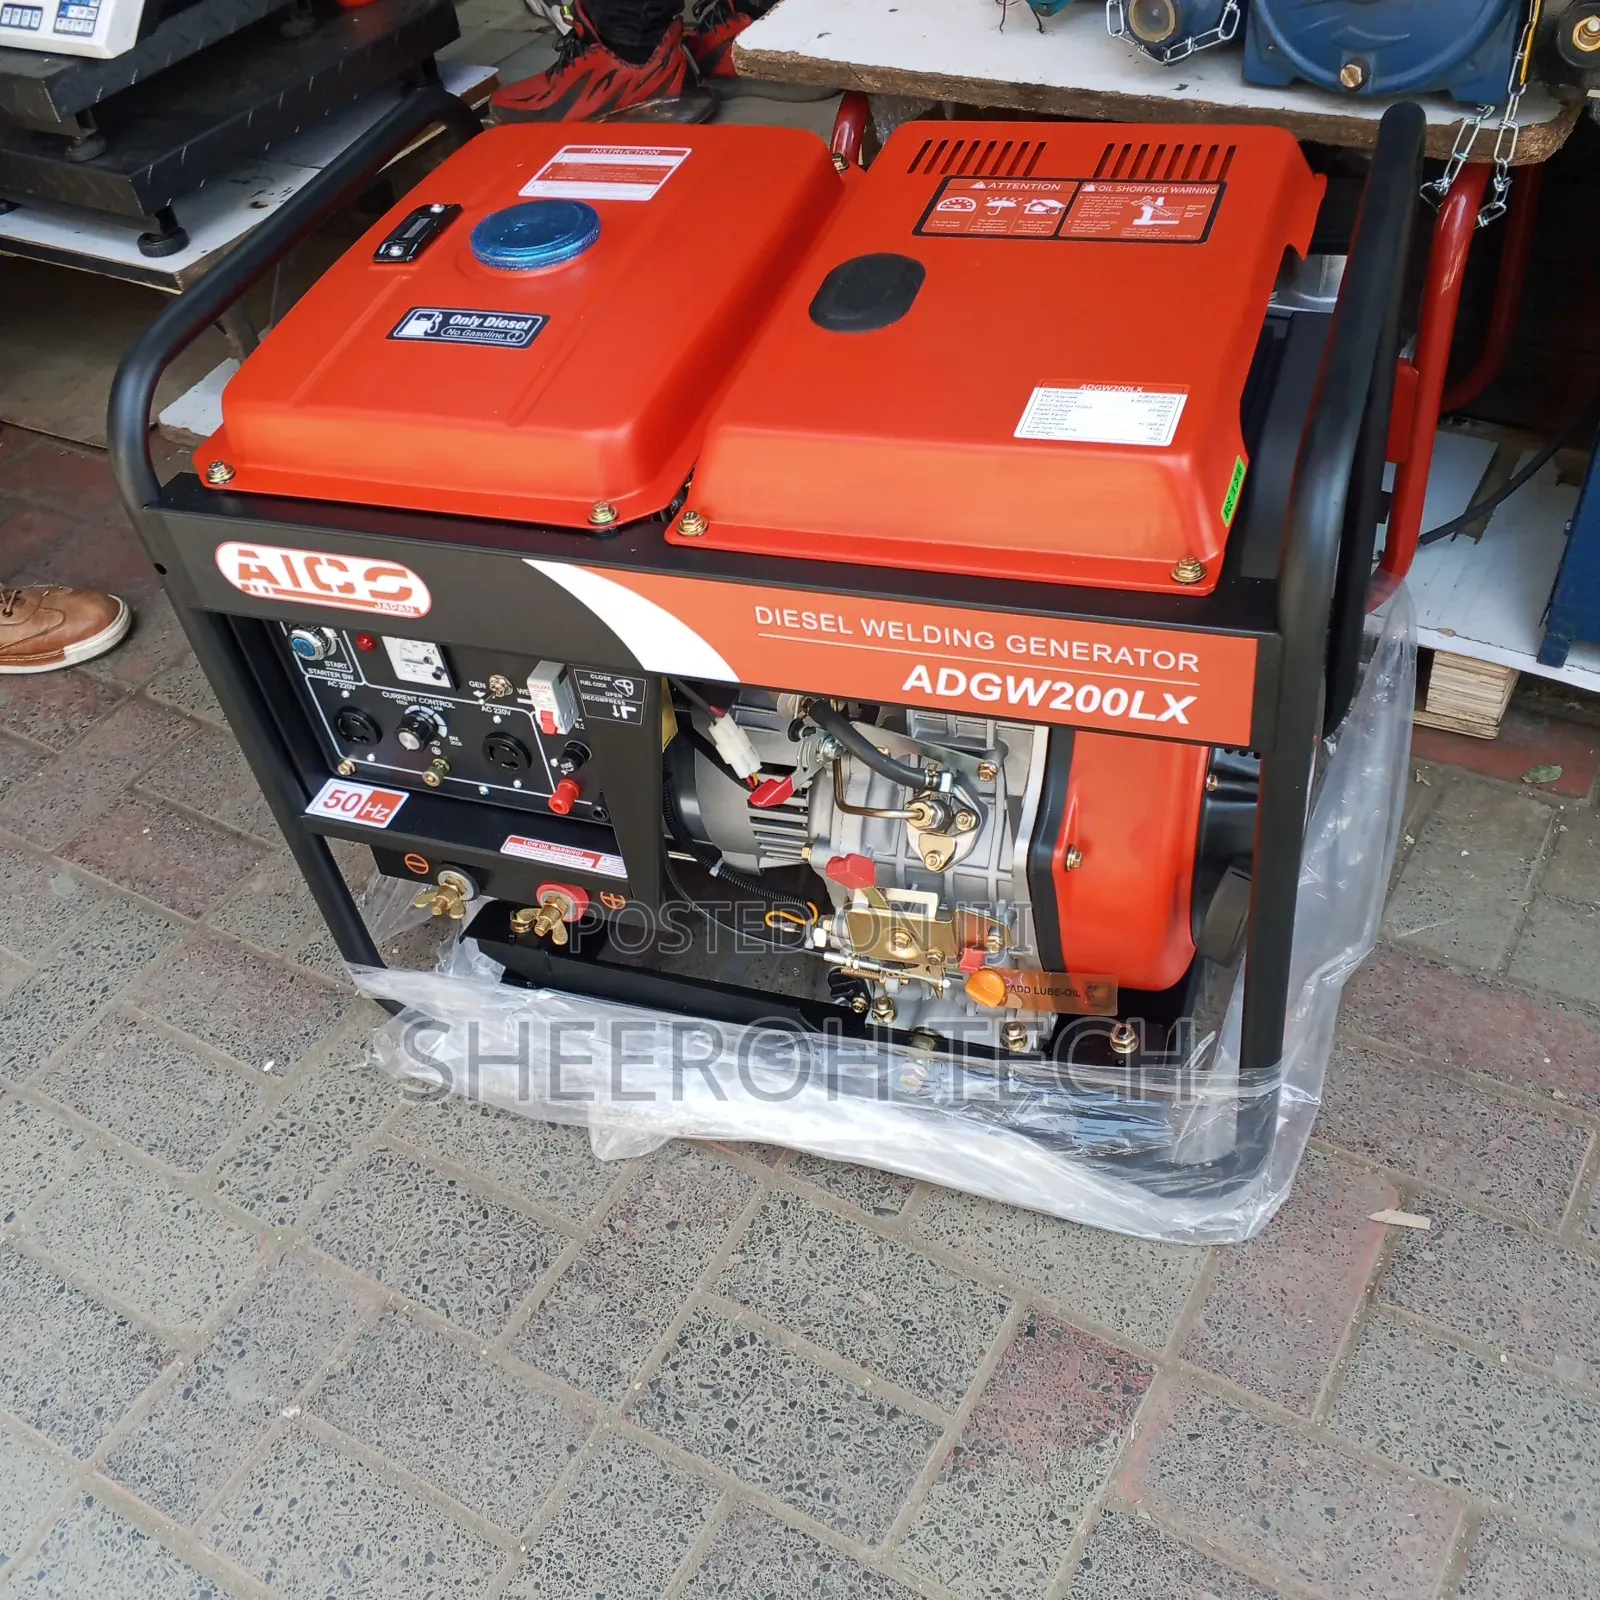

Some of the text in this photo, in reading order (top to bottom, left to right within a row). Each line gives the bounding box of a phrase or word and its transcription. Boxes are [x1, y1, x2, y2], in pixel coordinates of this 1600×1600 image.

[590, 148, 660, 156] INSTRUCTION
[987, 182, 1062, 191] ATTENTION
[1115, 186, 1168, 194] SHORTAGE
[1170, 187, 1218, 195] WARNING
[449, 314, 533, 330] Only Diesel
[447, 328, 505, 339] No Gasoline
[1078, 384, 1144, 393] ADGW200LX
[374, 602, 414, 614] JAPAN
[754, 606, 1200, 673] DIESEL WELDING GENERATOR
[324, 660, 348, 669] START
[307, 667, 341, 678] STARTER
[589, 674, 612, 682] CLOSE
[468, 680, 486, 689] GEN
[605, 691, 623, 699] OPEN
[902, 663, 1199, 725] ADGW200LX
[381, 691, 456, 709] CURRENT CONTROL
[582, 694, 626, 706] DECOMPRESS
[481, 705, 511, 716] AC 220V
[560, 760, 574, 769] FUSE
[323, 789, 391, 820] 50 Hz
[523, 840, 539, 848] LOW
[550, 845, 584, 856] WARNING!
[1010, 985, 1082, 998] ADD LUBE-OIL
